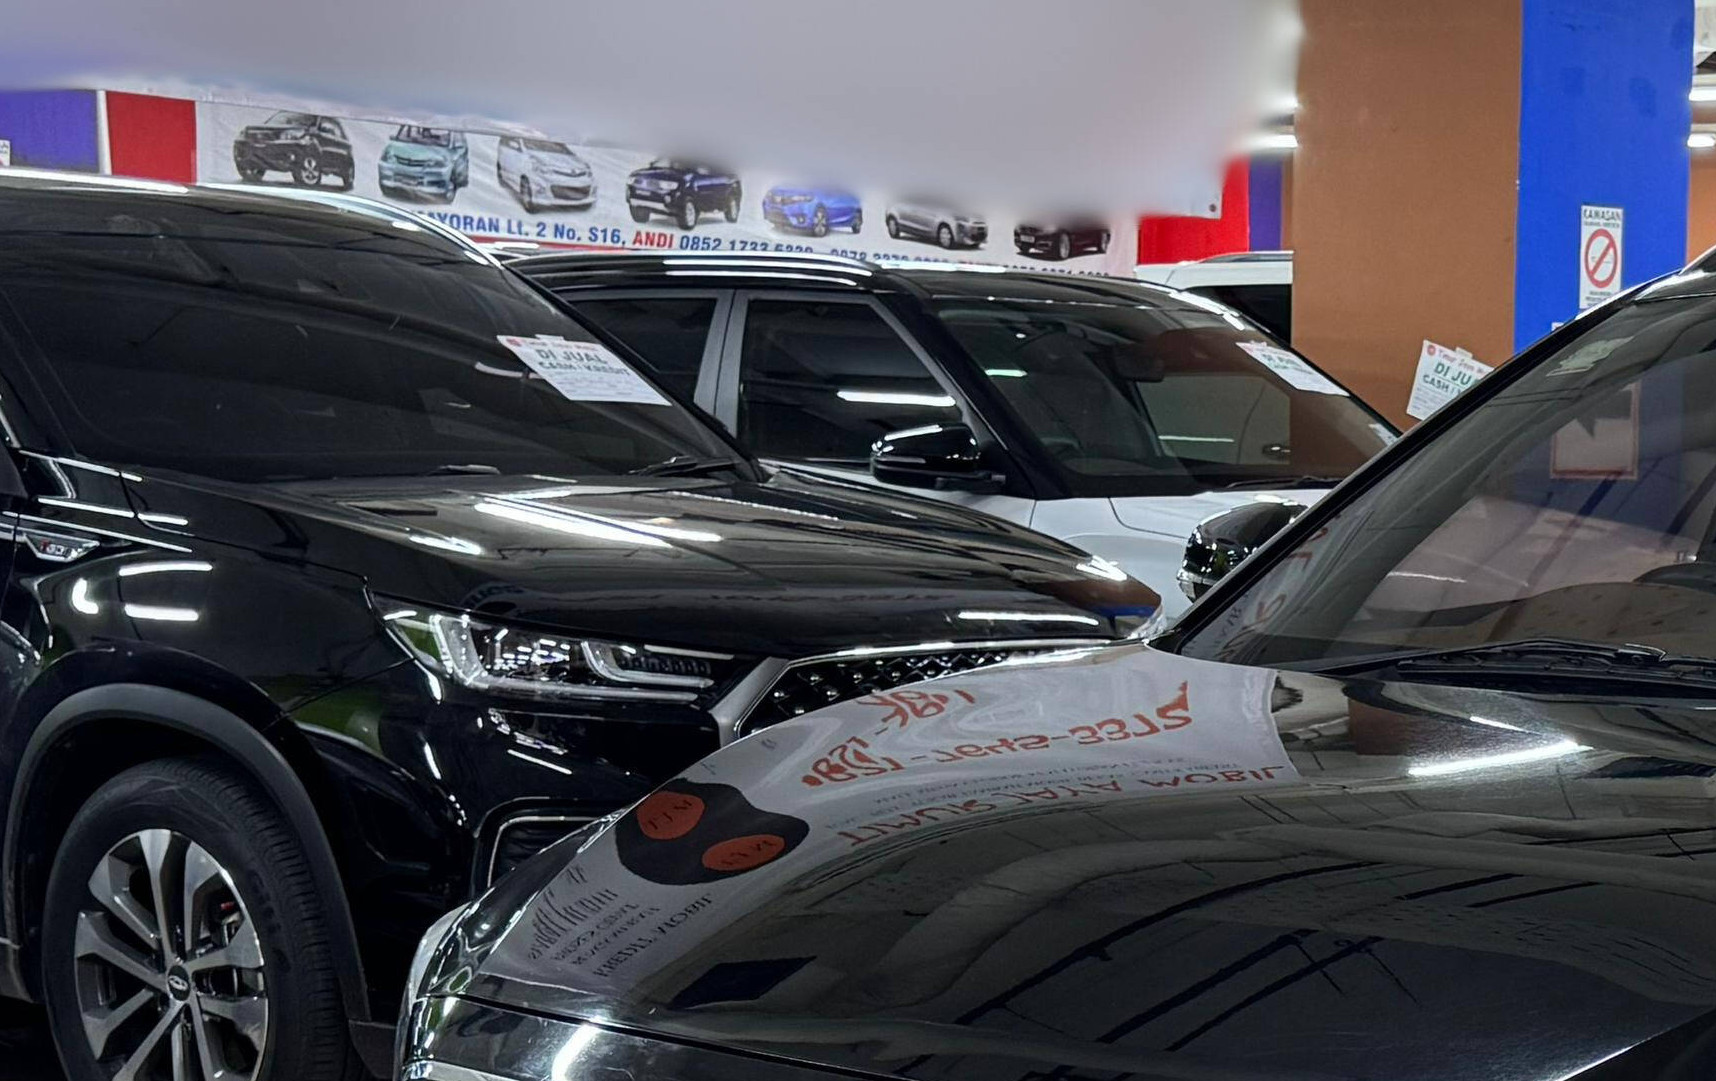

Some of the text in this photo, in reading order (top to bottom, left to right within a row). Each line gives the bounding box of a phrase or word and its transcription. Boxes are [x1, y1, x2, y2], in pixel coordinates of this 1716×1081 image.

[506, 220, 530, 237] Lt.
[536, 222, 547, 238] 2
[554, 224, 582, 242] No.
[588, 226, 626, 246] S16,
[632, 231, 674, 248] ANDI
[680, 236, 721, 251] 0852
[536, 349, 608, 365] DI JUAL
[1422, 374, 1450, 393] CASH
[1434, 362, 1450, 377] DI
[1451, 371, 1479, 386] JU
